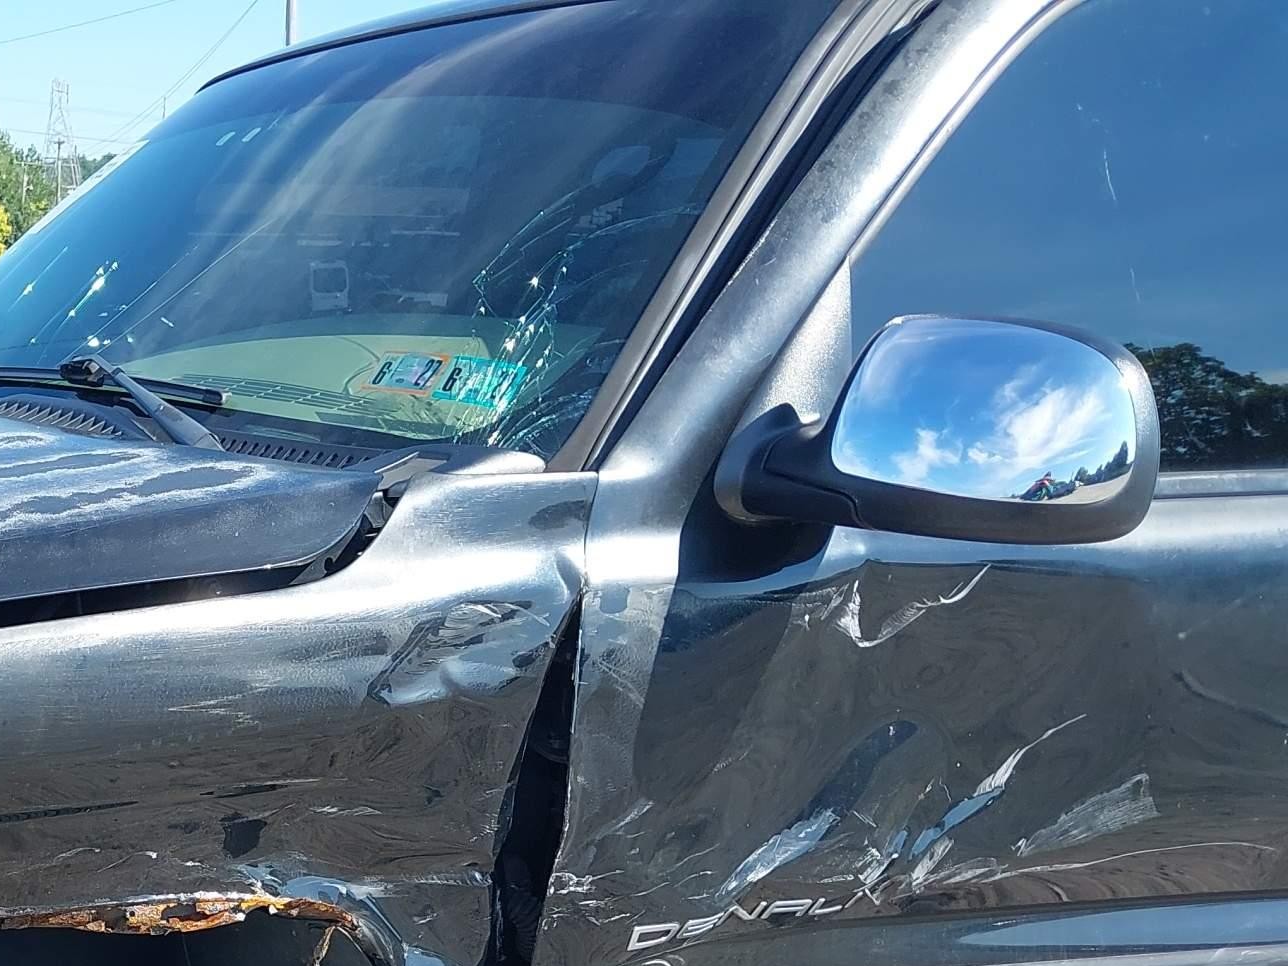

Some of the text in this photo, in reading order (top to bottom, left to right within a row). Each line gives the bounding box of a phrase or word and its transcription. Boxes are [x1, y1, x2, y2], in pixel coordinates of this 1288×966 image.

[371, 358, 443, 388] 6 27
[441, 367, 463, 392] 6
